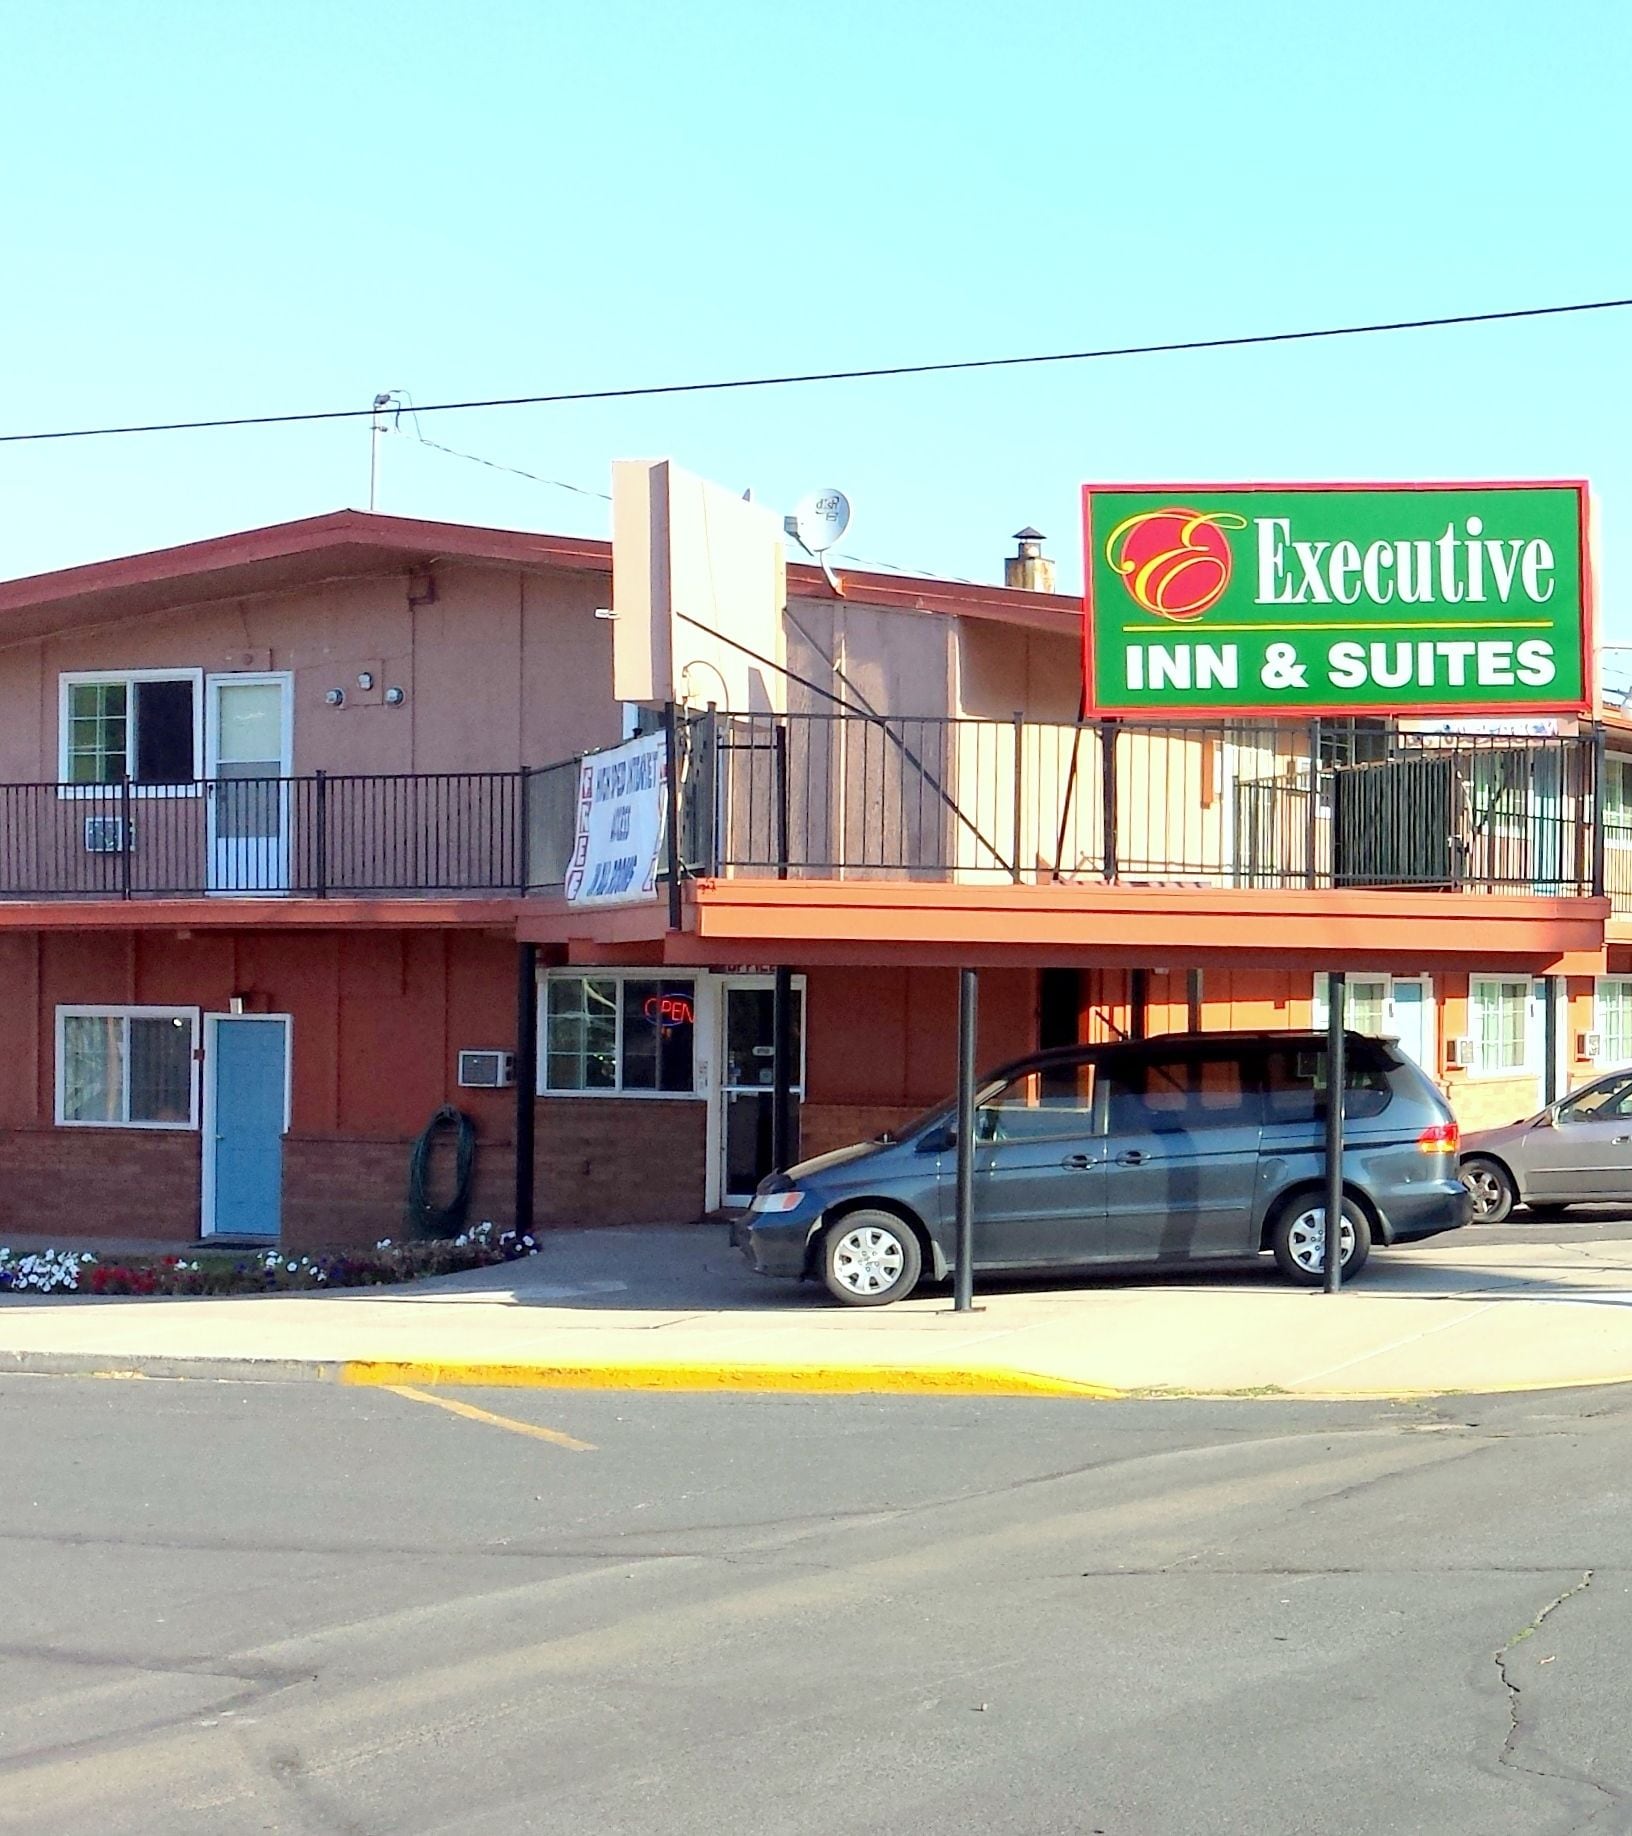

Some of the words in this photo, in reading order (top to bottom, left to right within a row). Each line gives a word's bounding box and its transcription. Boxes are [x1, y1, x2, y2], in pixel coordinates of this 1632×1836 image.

[816, 497, 839, 510] dish
[1253, 516, 1557, 605] Executive
[1125, 643, 1239, 690] INN
[1260, 641, 1309, 690] &
[1327, 639, 1557, 688] SUITES
[645, 998, 696, 1023] OPEN
